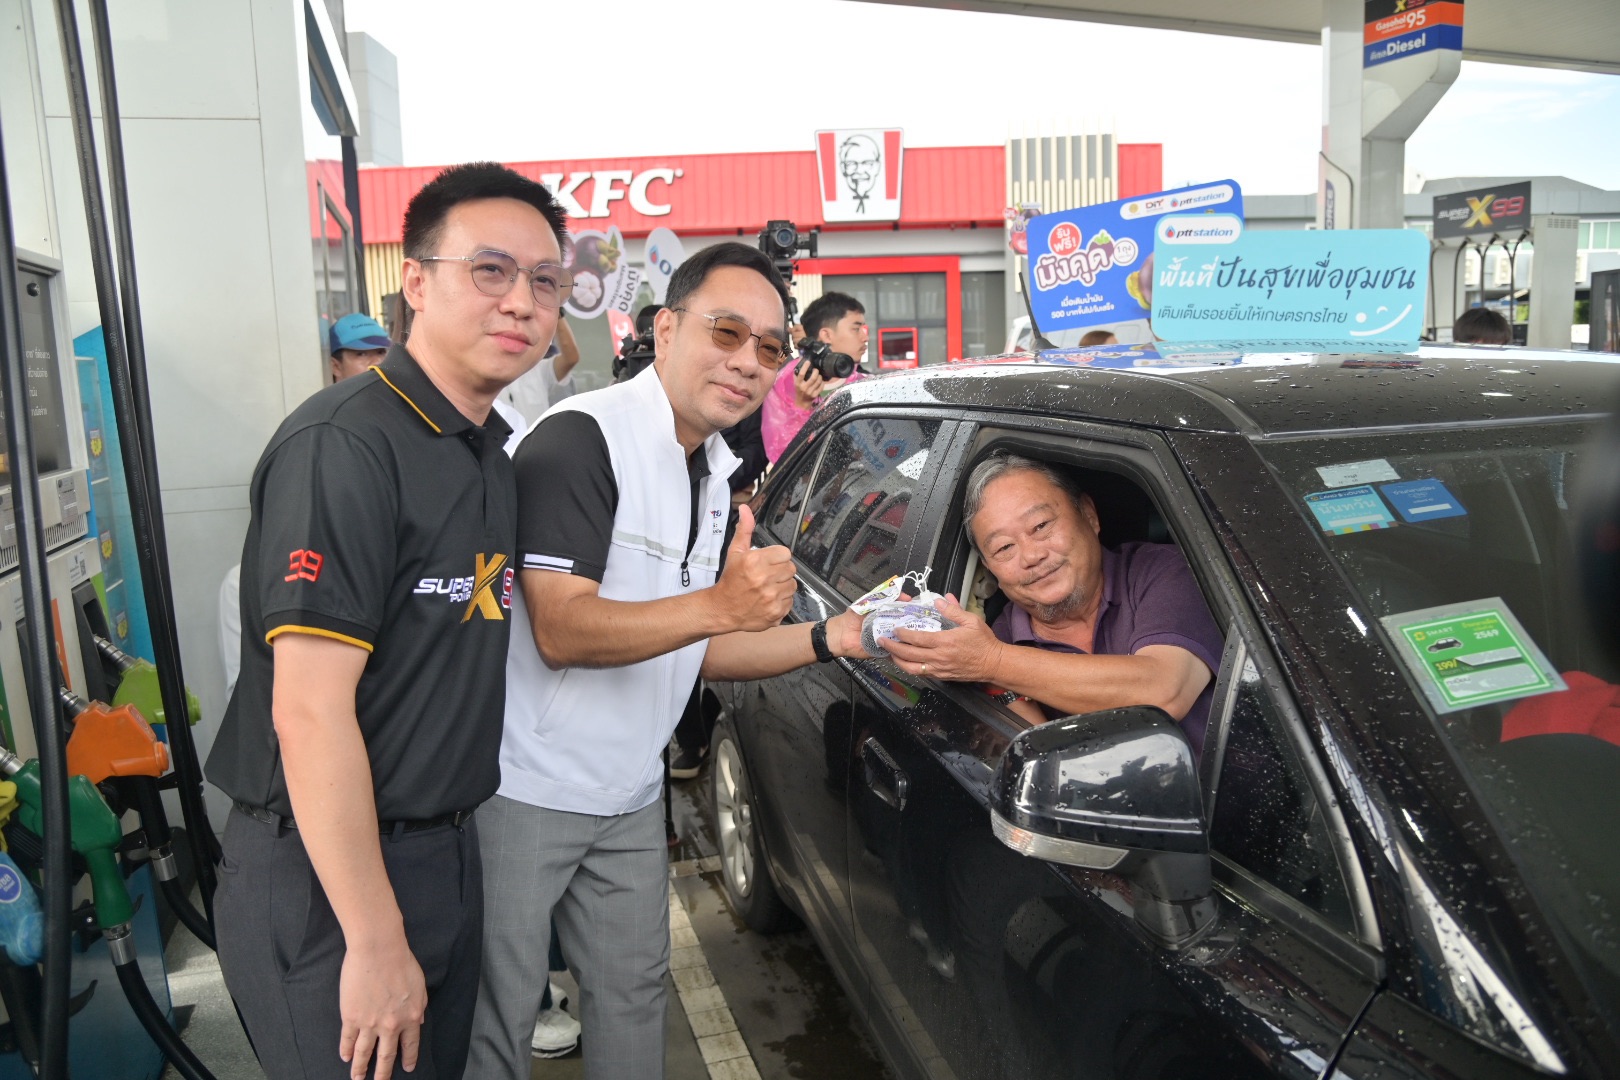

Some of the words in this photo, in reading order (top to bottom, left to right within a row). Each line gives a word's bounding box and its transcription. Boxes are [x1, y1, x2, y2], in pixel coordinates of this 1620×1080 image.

[1406, 9, 1426, 29] 95
[1386, 32, 1427, 56] Diesel
[540, 168, 675, 218] KFC
[1326, 190, 1334, 230] ORCE
[1460, 193, 1497, 230] X
[1491, 195, 1525, 219] 99
[1193, 227, 1234, 238] station
[1037, 248, 1111, 287] มังคุด
[618, 269, 640, 313] มังคุด
[1050, 309, 1065, 319] 500
[460, 552, 509, 625] X
